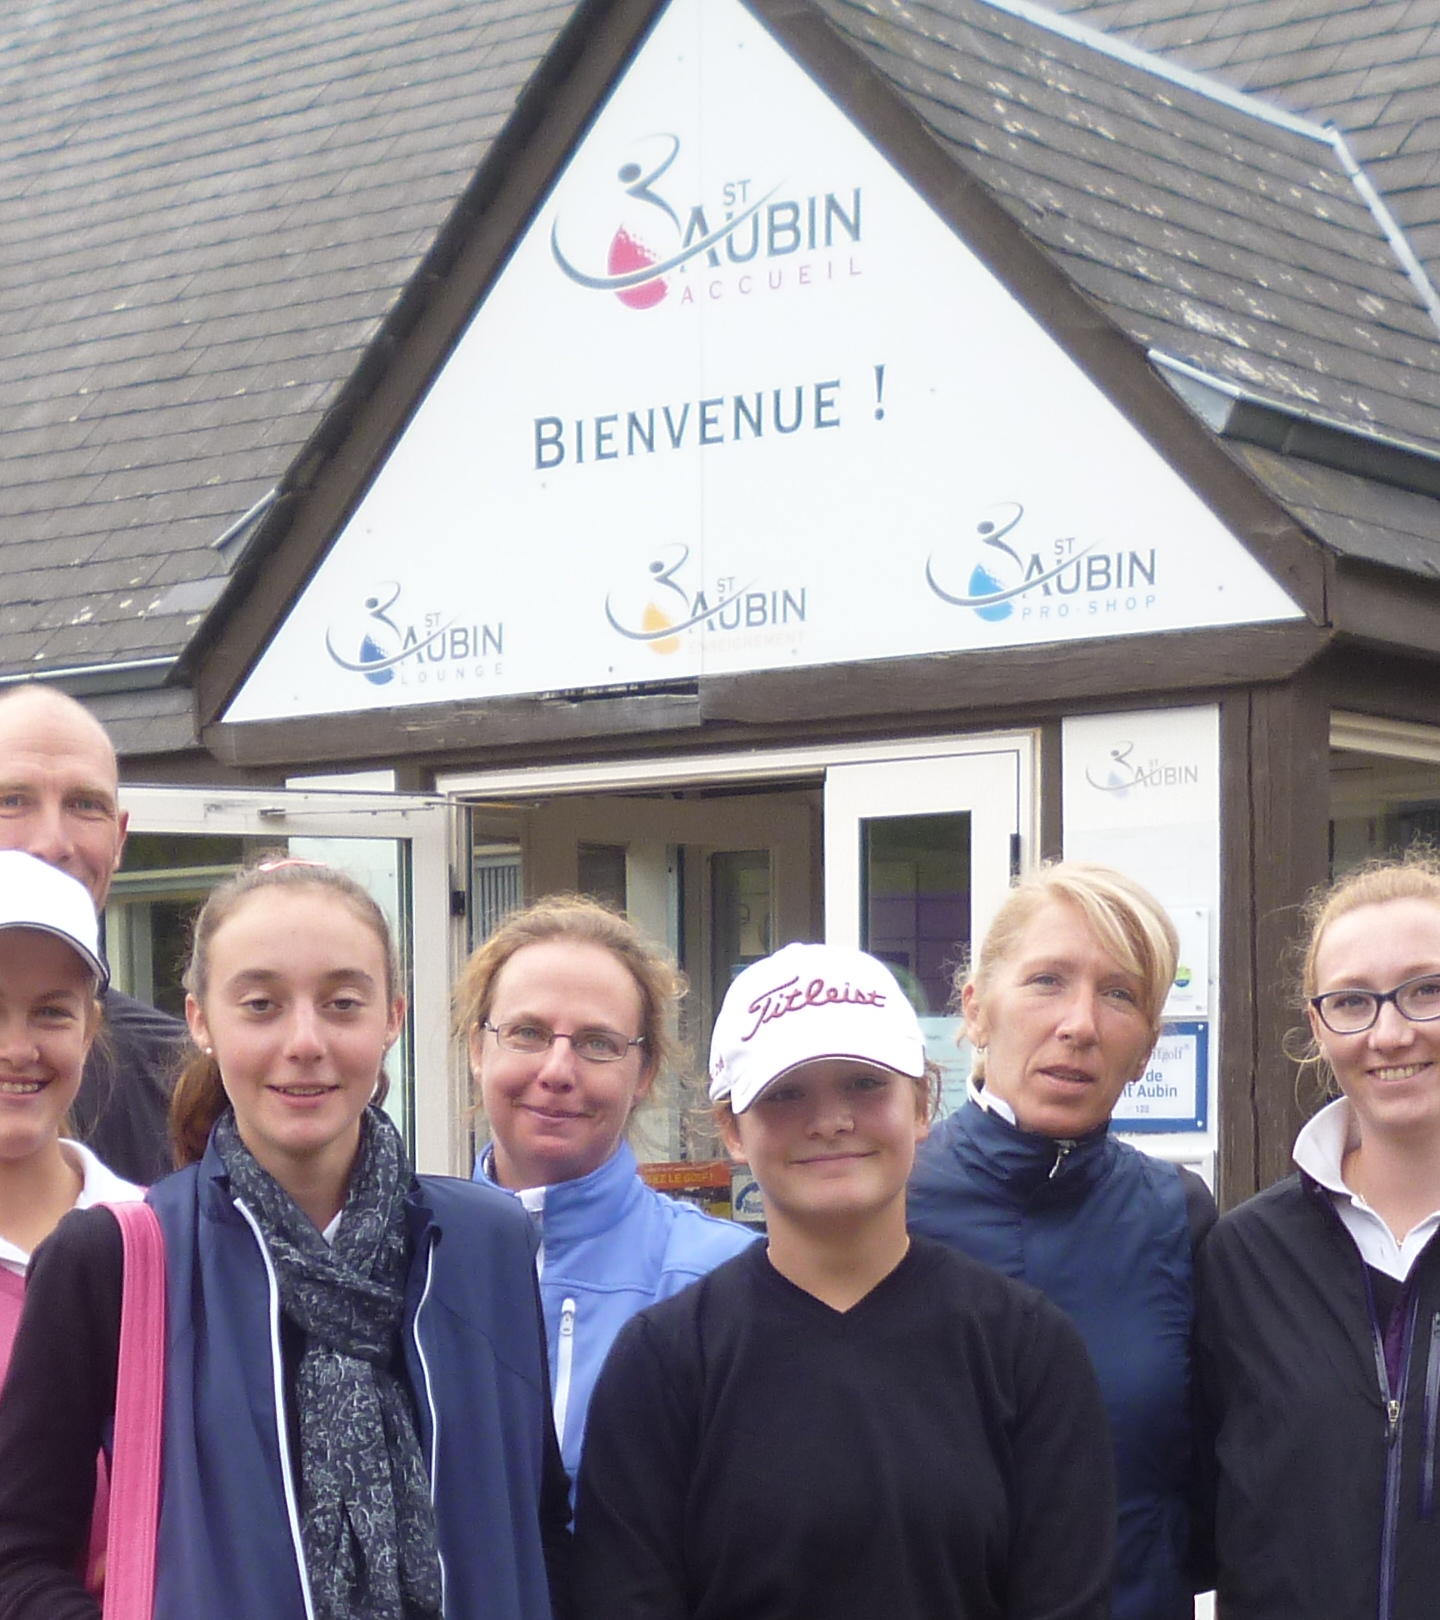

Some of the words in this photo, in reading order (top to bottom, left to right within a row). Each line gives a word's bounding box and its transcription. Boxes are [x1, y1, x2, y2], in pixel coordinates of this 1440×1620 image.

[723, 178, 751, 206] ST
[681, 187, 862, 273] AUBIN
[681, 257, 862, 305] ACCUEIL
[533, 378, 841, 471] BIENVENUE
[873, 363, 885, 421] !
[1054, 537, 1075, 556] ST
[717, 577, 735, 594] ST
[1022, 548, 1157, 598] AUBIN
[425, 613, 441, 627] ST
[688, 587, 807, 633] AUBIN
[401, 623, 504, 664] AUBIN
[400, 663, 504, 686] LOUNGE
[1134, 765, 1198, 789] AUBIN
[741, 976, 887, 1042] Titleist
[1145, 1069, 1163, 1083] de
[1136, 1084, 1178, 1098] Aubin
